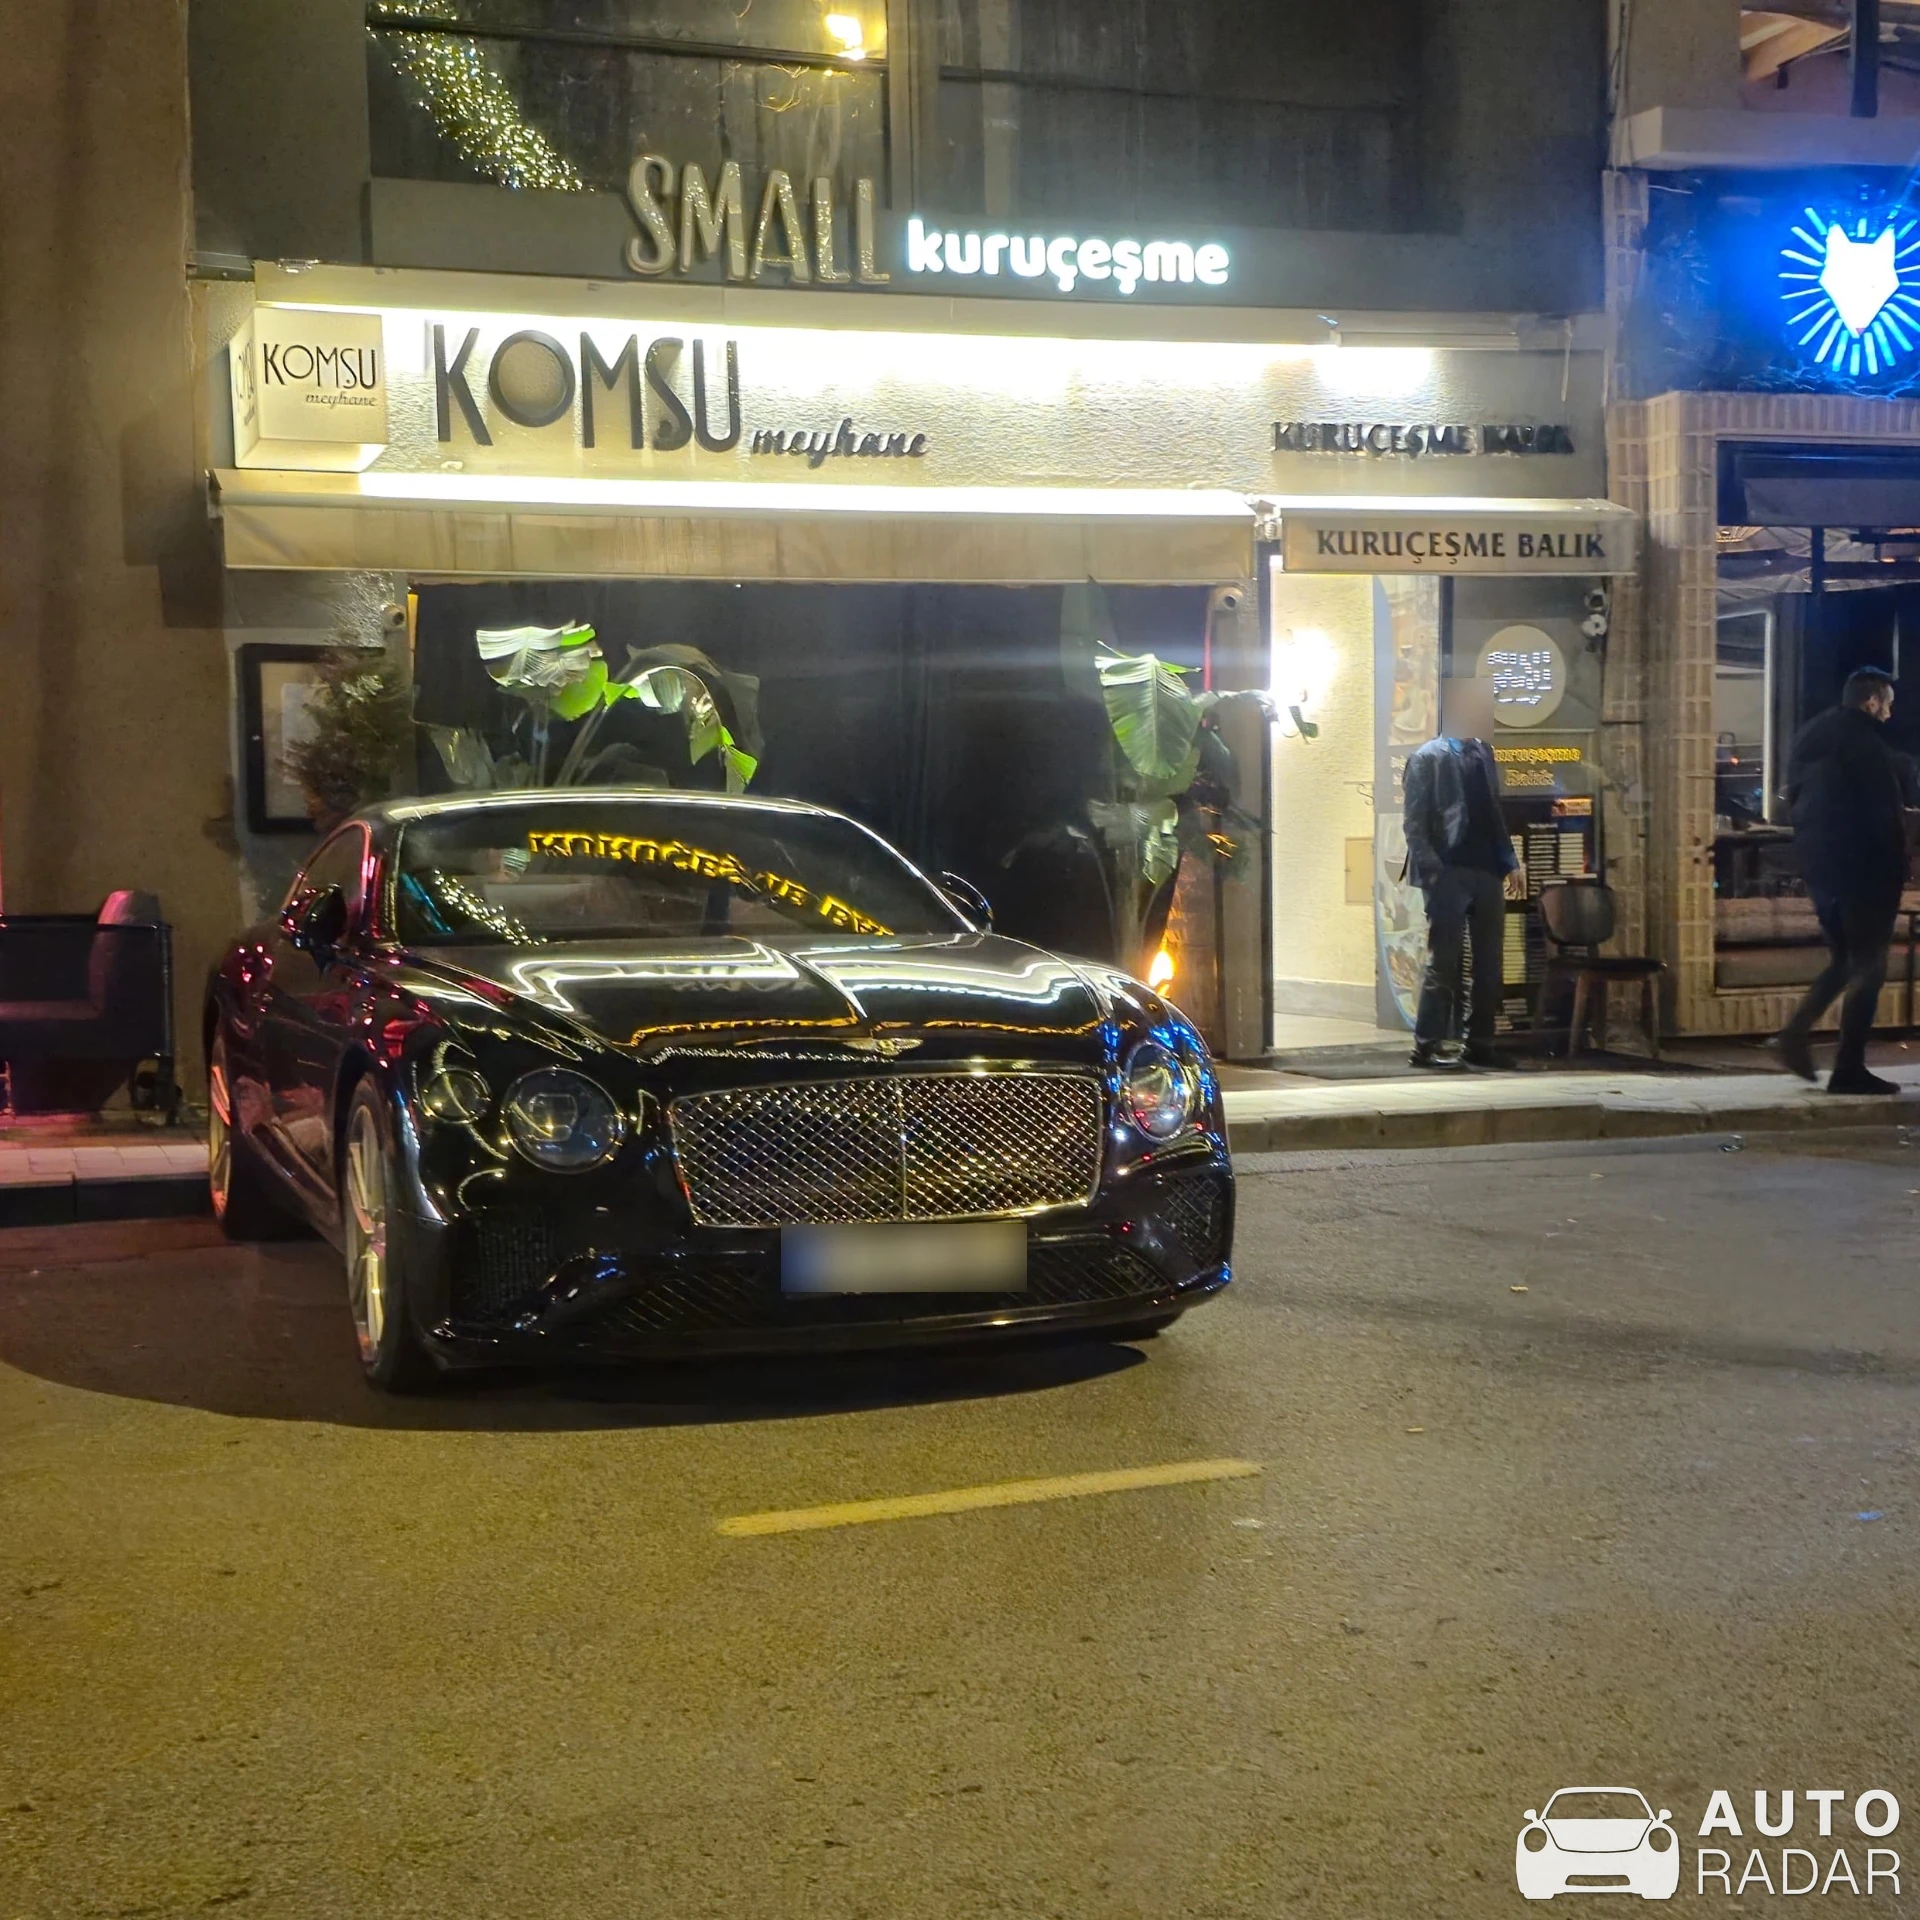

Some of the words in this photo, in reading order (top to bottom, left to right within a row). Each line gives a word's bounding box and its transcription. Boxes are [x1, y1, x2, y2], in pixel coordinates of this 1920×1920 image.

[625, 154, 891, 286] SMALL
[907, 214, 1230, 295] kuruçeşme
[263, 342, 377, 390] KOMSU
[305, 391, 379, 409] meyhane
[433, 323, 742, 453] KOMSU
[752, 418, 928, 470] meyhane
[1316, 529, 1507, 565] KURUÇEŞME
[1518, 533, 1606, 558] BALIK
[1493, 748, 1581, 765] uruçeşme
